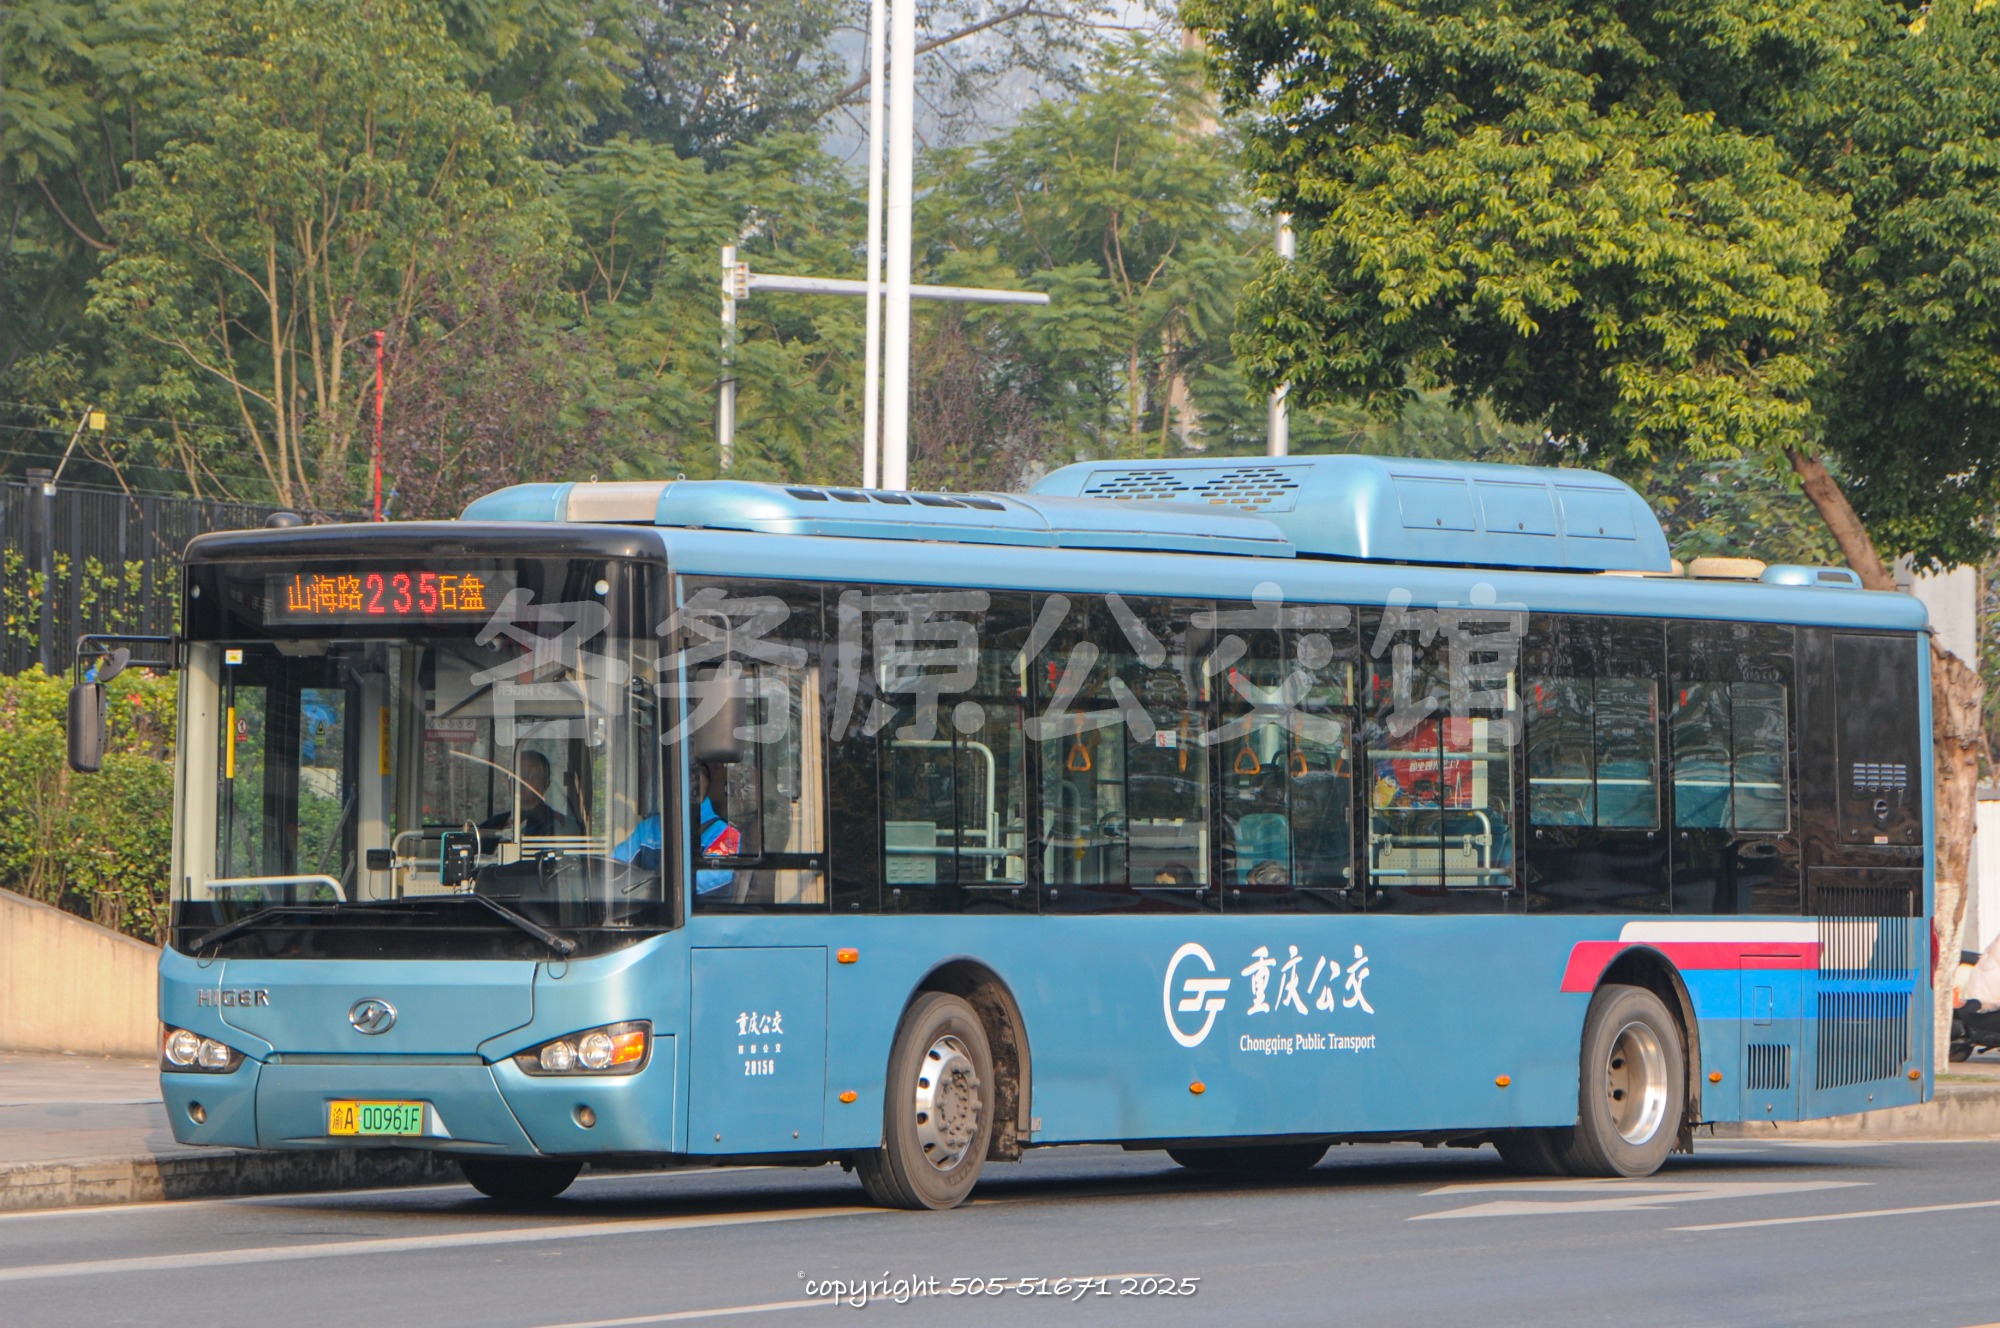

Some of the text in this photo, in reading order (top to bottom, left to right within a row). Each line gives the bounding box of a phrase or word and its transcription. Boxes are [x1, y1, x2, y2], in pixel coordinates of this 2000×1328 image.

[1240, 944, 1375, 1016] 重庆公交
[198, 988, 269, 1007] HIGER
[736, 1010, 784, 1036] 重庆公交
[1240, 1033, 1376, 1055] Chongqing Public Transport
